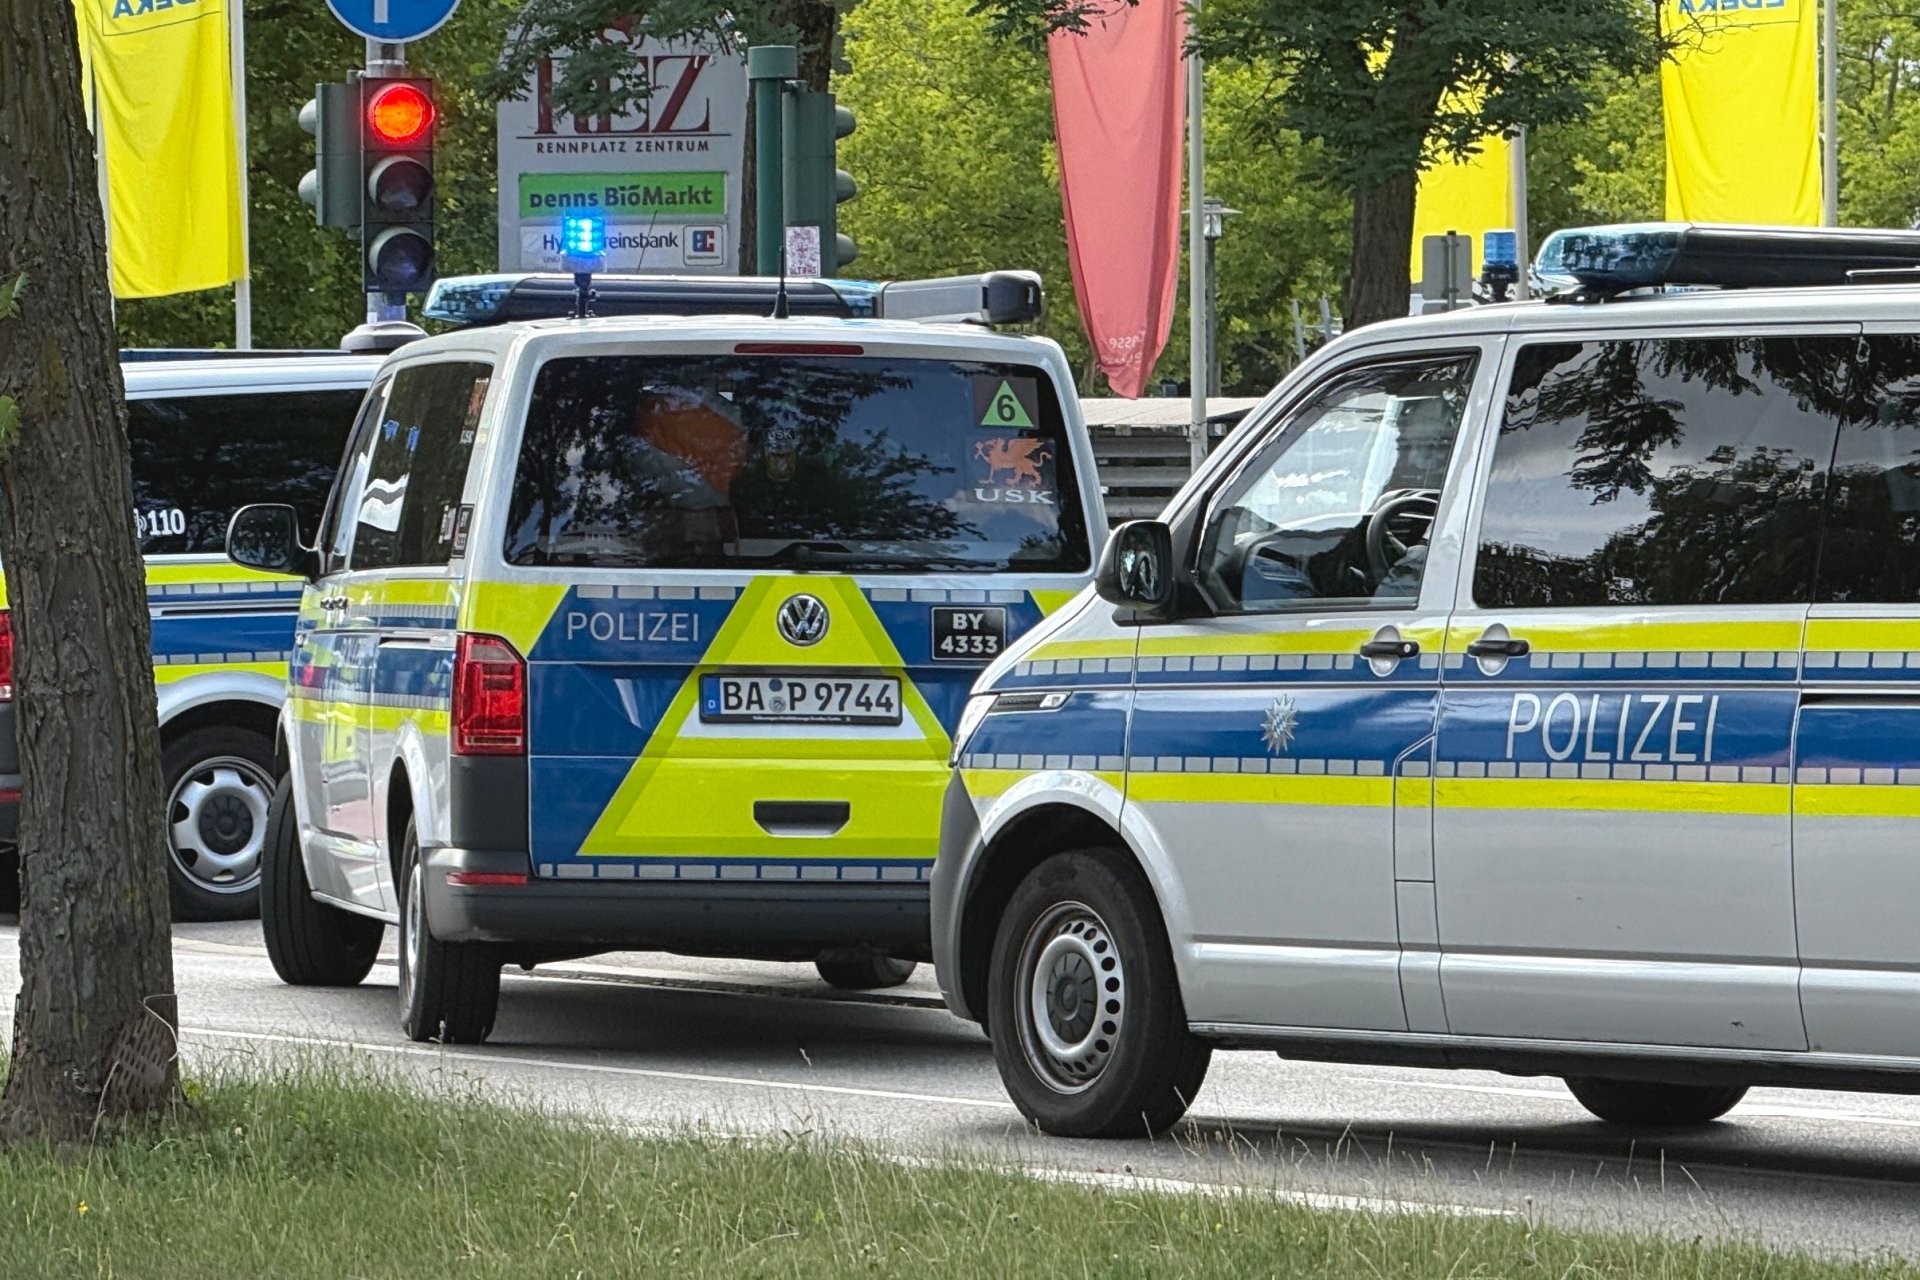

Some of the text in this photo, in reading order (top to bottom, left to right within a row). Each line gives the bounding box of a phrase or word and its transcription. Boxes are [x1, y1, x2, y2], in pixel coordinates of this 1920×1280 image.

[536, 140, 709, 154] RENNPLATZ ZENTRUM
[997, 394, 1016, 422] 6
[974, 488, 1055, 505] USK
[147, 508, 186, 536] 110
[567, 611, 699, 642] POLIZEI
[952, 612, 984, 630] BY
[940, 635, 998, 654] 4333
[722, 681, 894, 713] BA P 9744
[1506, 692, 1719, 763] POLIZEI
